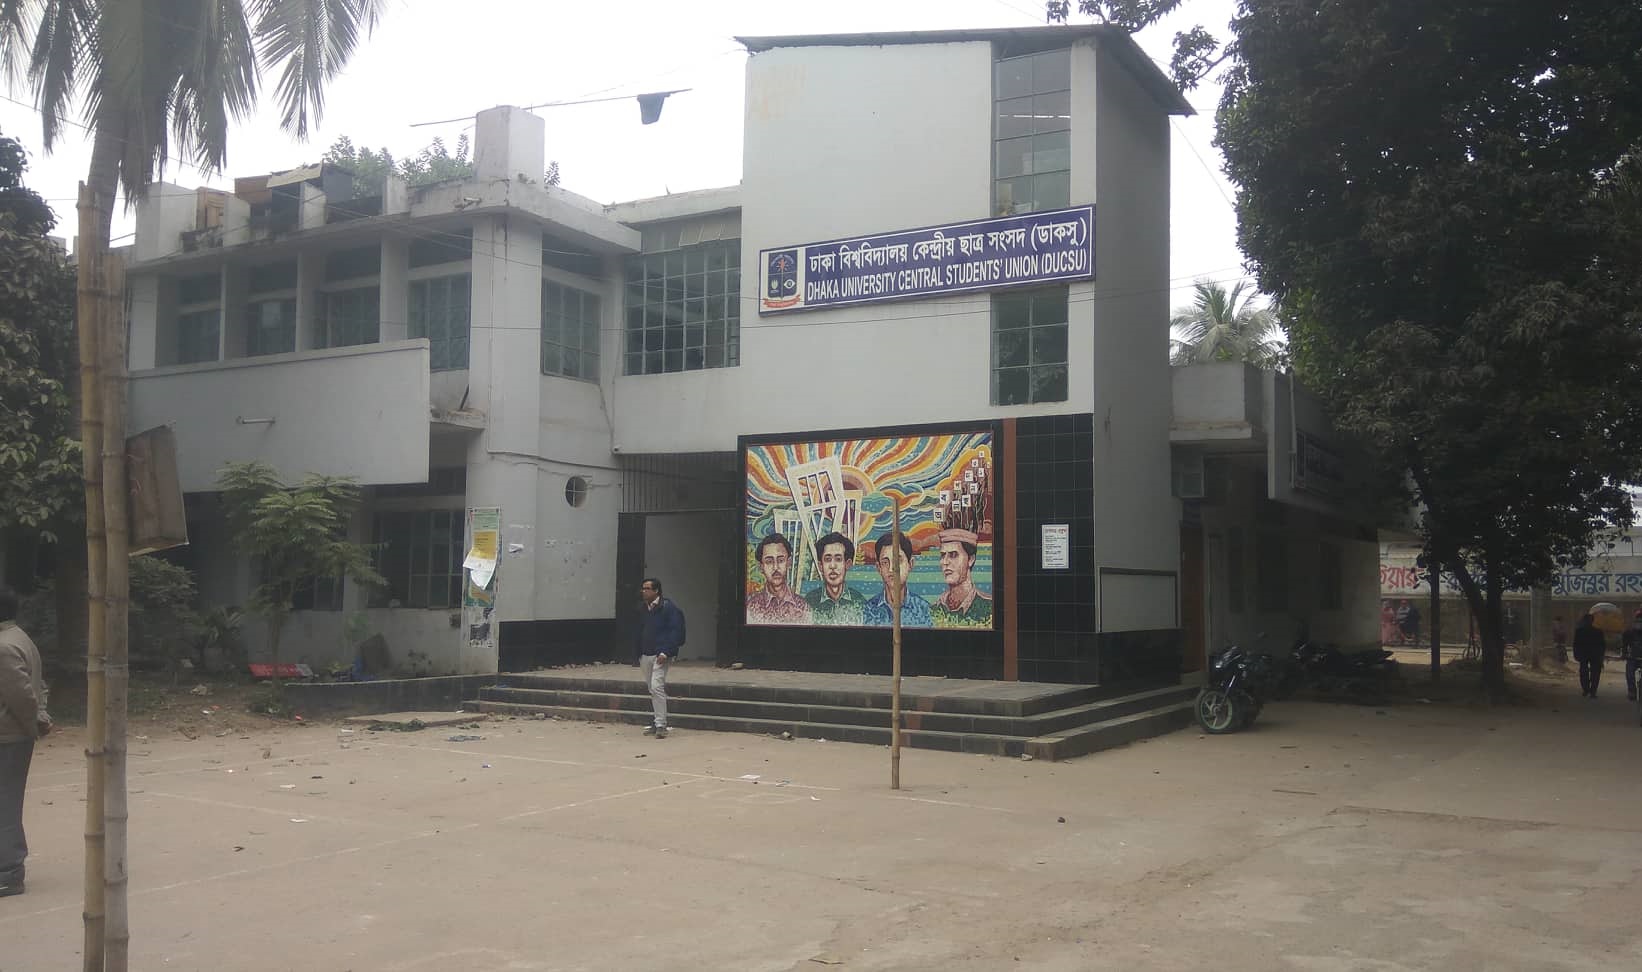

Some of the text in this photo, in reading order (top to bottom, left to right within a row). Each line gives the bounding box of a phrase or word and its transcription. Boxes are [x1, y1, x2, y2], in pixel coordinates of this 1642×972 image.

[809, 217, 1087, 273] ঢাকা বিশ্ববিদ্যালয় কেন্দ্রীয় ছাত্র সংসদ (ডাকসু)
[807, 248, 1087, 301] DHAKA UNIVERSITY CENTRAL STUDENTS' UNION (DUCSU)
